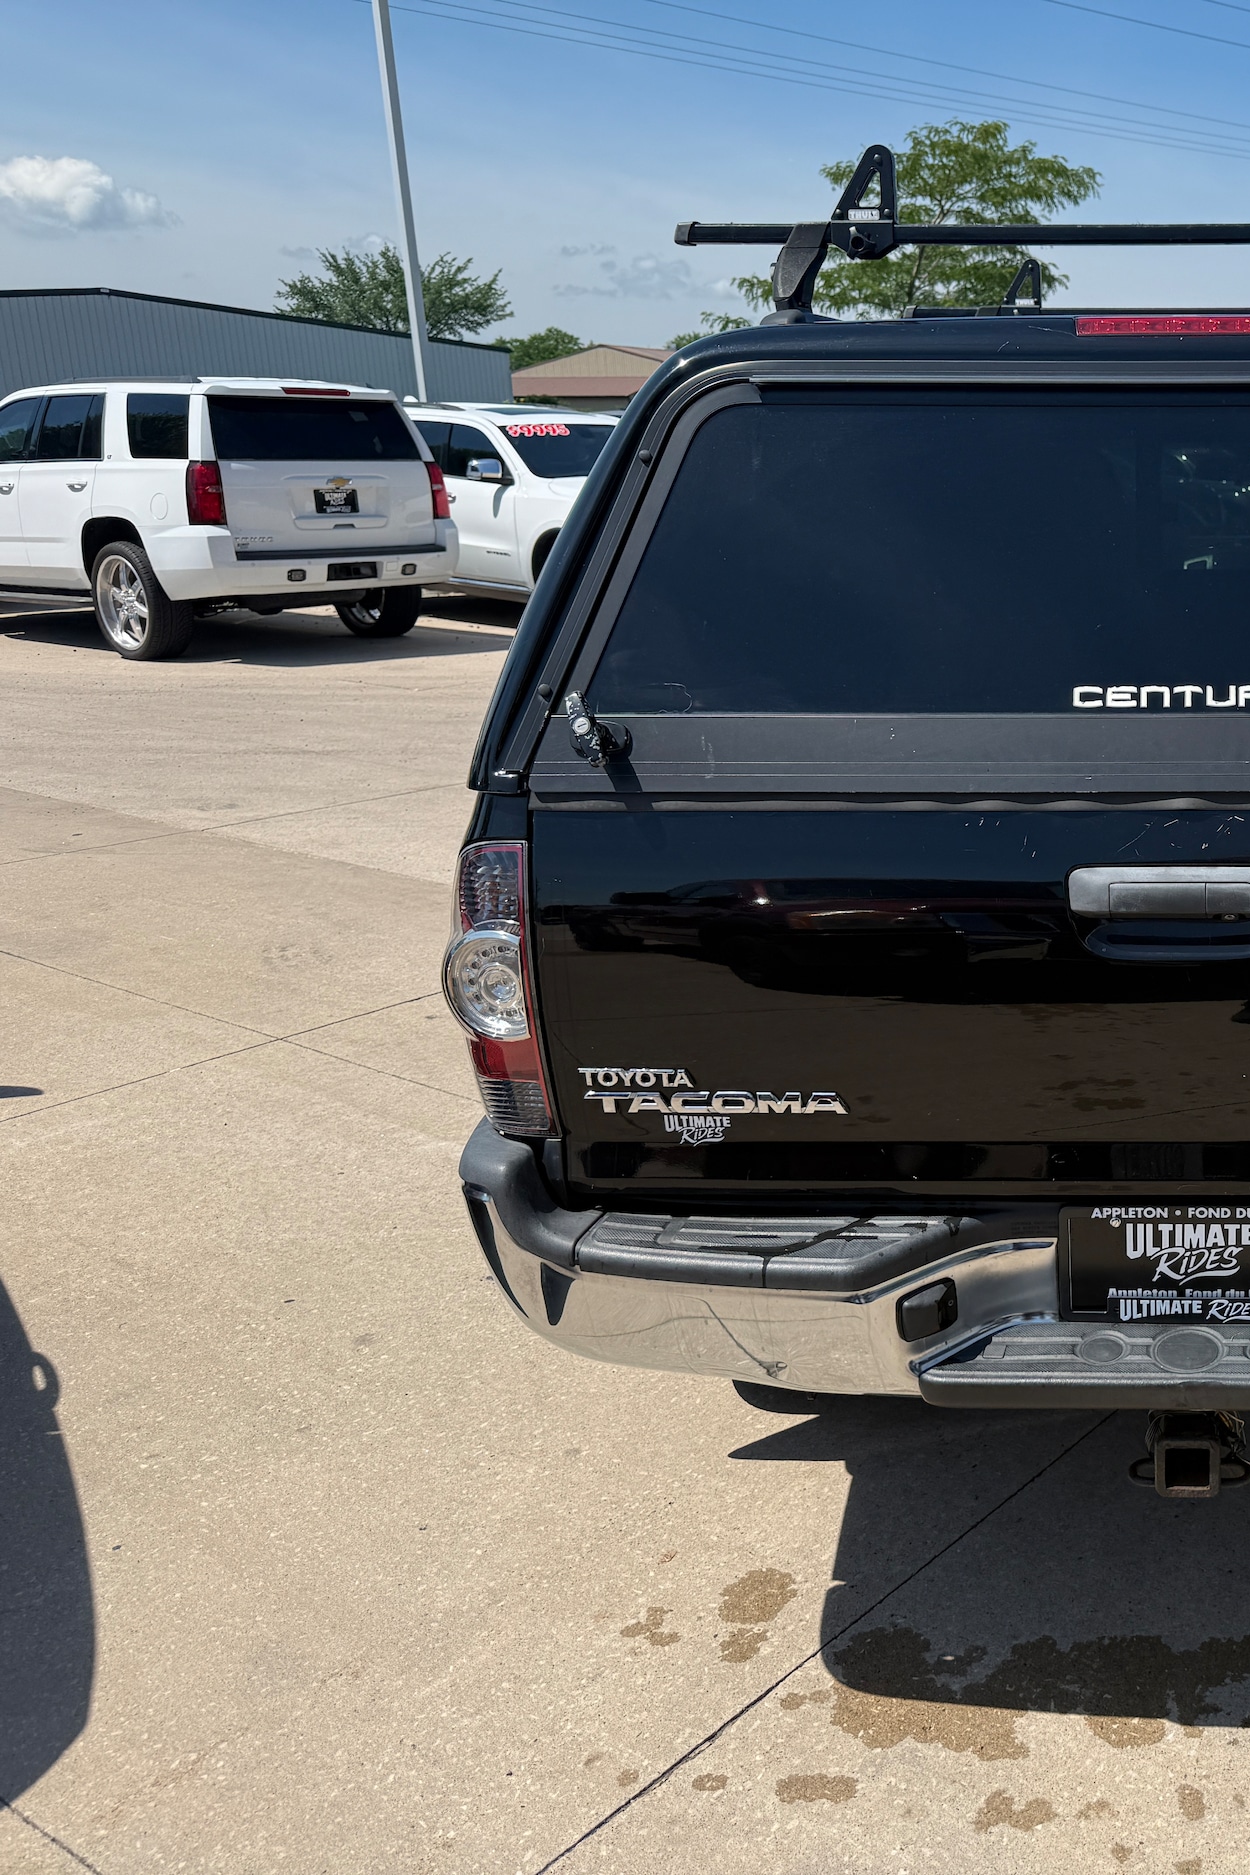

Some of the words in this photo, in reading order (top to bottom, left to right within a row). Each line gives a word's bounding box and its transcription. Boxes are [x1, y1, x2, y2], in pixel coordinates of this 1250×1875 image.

[577, 1067, 696, 1088] TOYOTA
[584, 1090, 849, 1115] TACOMA
[663, 1115, 731, 1133] ULTIMATE
[1091, 1207, 1169, 1219] APPLETON
[1187, 1207, 1232, 1219] FOND
[1185, 1288, 1222, 1299] Fond
[1119, 1299, 1203, 1322] ULTIMATE
